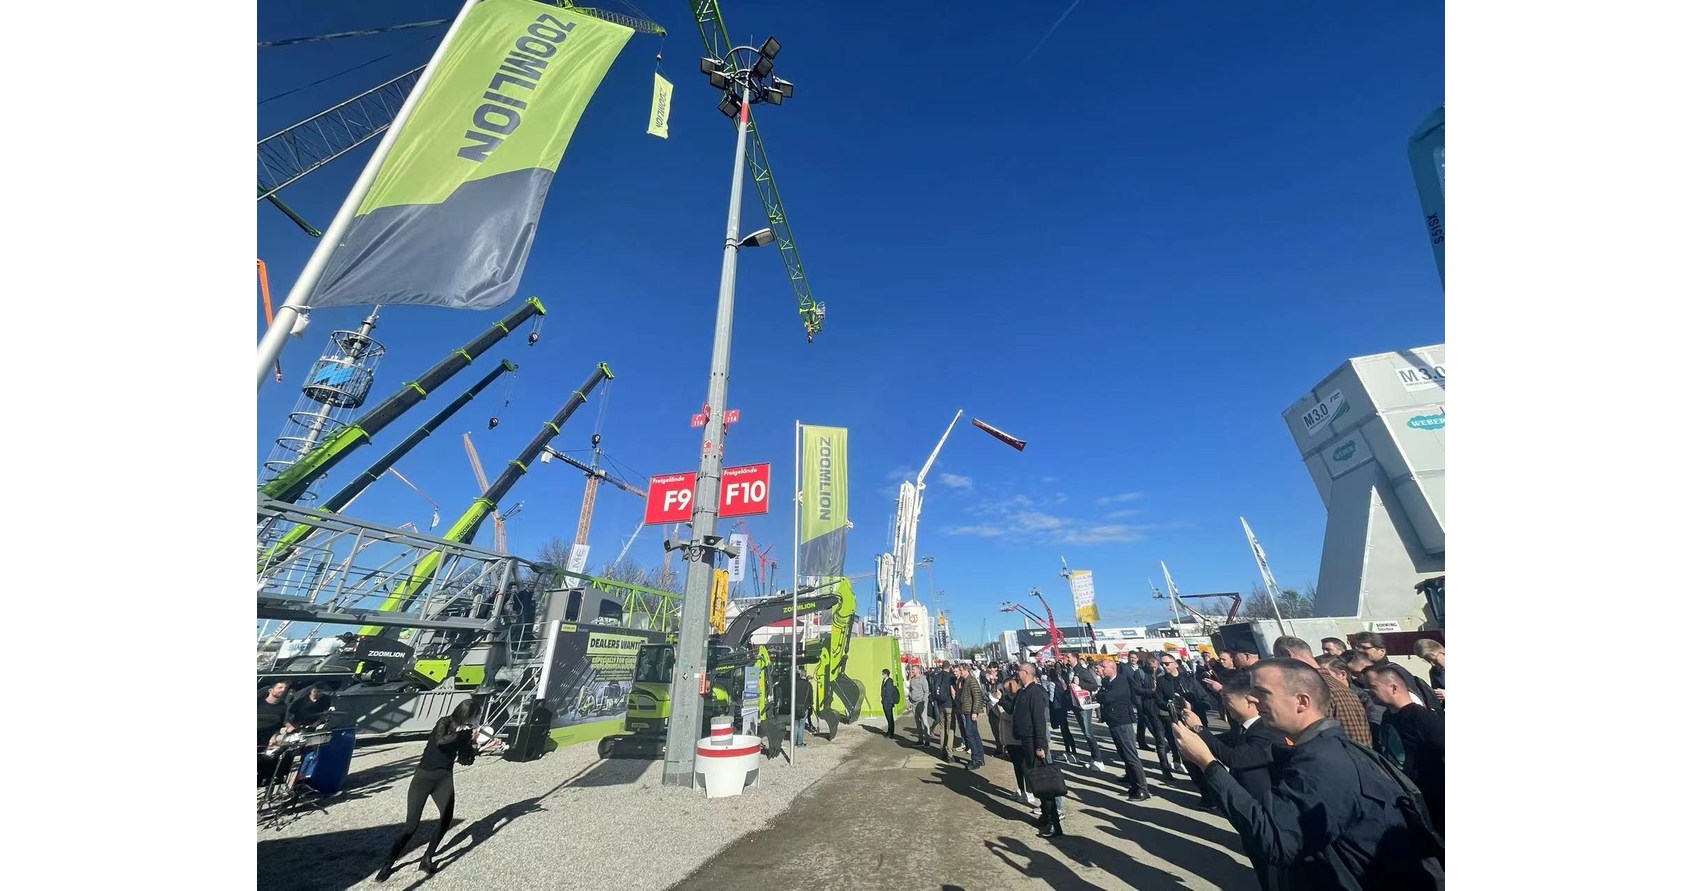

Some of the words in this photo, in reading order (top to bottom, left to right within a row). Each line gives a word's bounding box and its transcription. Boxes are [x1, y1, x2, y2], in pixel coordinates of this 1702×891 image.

[457, 13, 577, 163] ZOOMLION
[652, 476, 685, 484] Freigelände
[723, 467, 757, 476] Freigelände
[819, 436, 832, 521] ZOOMLION
[663, 488, 692, 512] F9
[725, 480, 766, 505] F10
[590, 638, 620, 649] DEALERS
[367, 650, 406, 658] ZOOMLION
